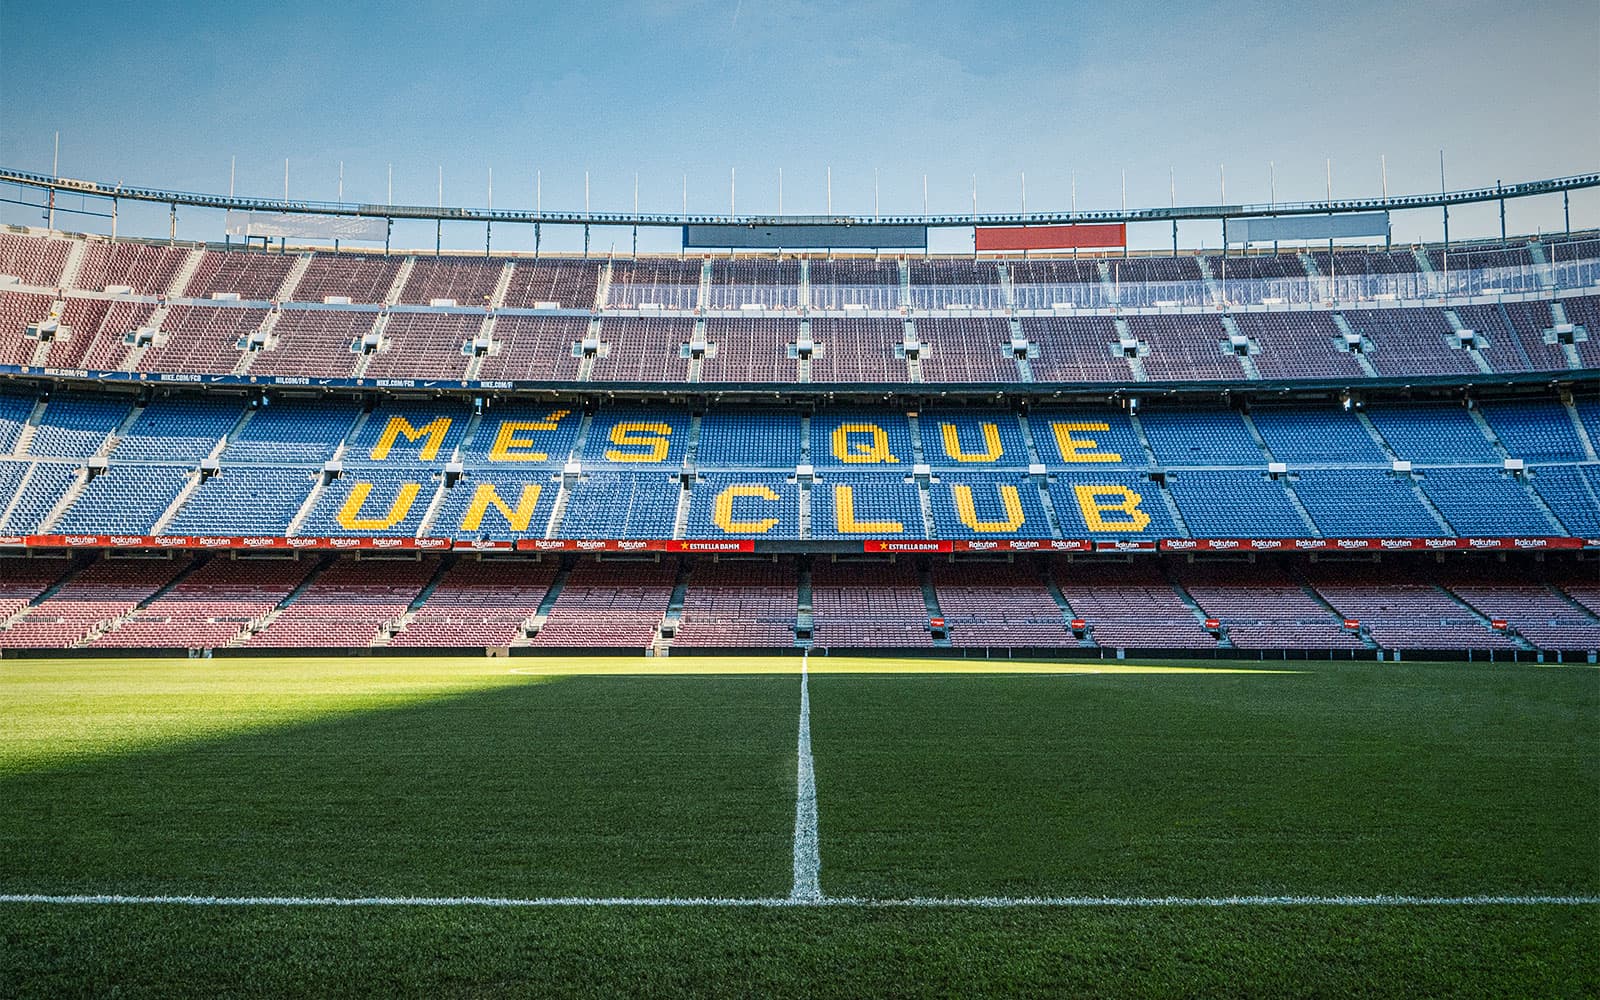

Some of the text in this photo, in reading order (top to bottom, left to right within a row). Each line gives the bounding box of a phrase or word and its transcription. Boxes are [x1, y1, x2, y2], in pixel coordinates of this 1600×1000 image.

[370, 410, 1122, 463] MÉS QUE
[336, 484, 1151, 533] UN CLUB
[66, 537, 97, 545] Rakuten
[111, 537, 141, 545] Rakuten
[155, 537, 186, 545] Rakuten
[200, 538, 230, 546] Rakuten
[244, 538, 274, 546] Rakuten
[373, 539, 402, 547] Rakuten
[415, 539, 444, 547] Rakuten
[536, 541, 647, 549] Rakuten Rakuten Rakuten
[969, 541, 1081, 549] Rakuten Rakuten Rakuten
[1167, 540, 1196, 548] Rakuten
[1209, 540, 1239, 548] Rakuten
[1252, 540, 1281, 548] Rakuten
[1296, 540, 1326, 548] Rakuten
[1338, 540, 1368, 548] Rakuten
[1426, 539, 1456, 547] Rakuten
[1470, 539, 1500, 547] Rakuten
[1515, 539, 1546, 547] Rakuten
